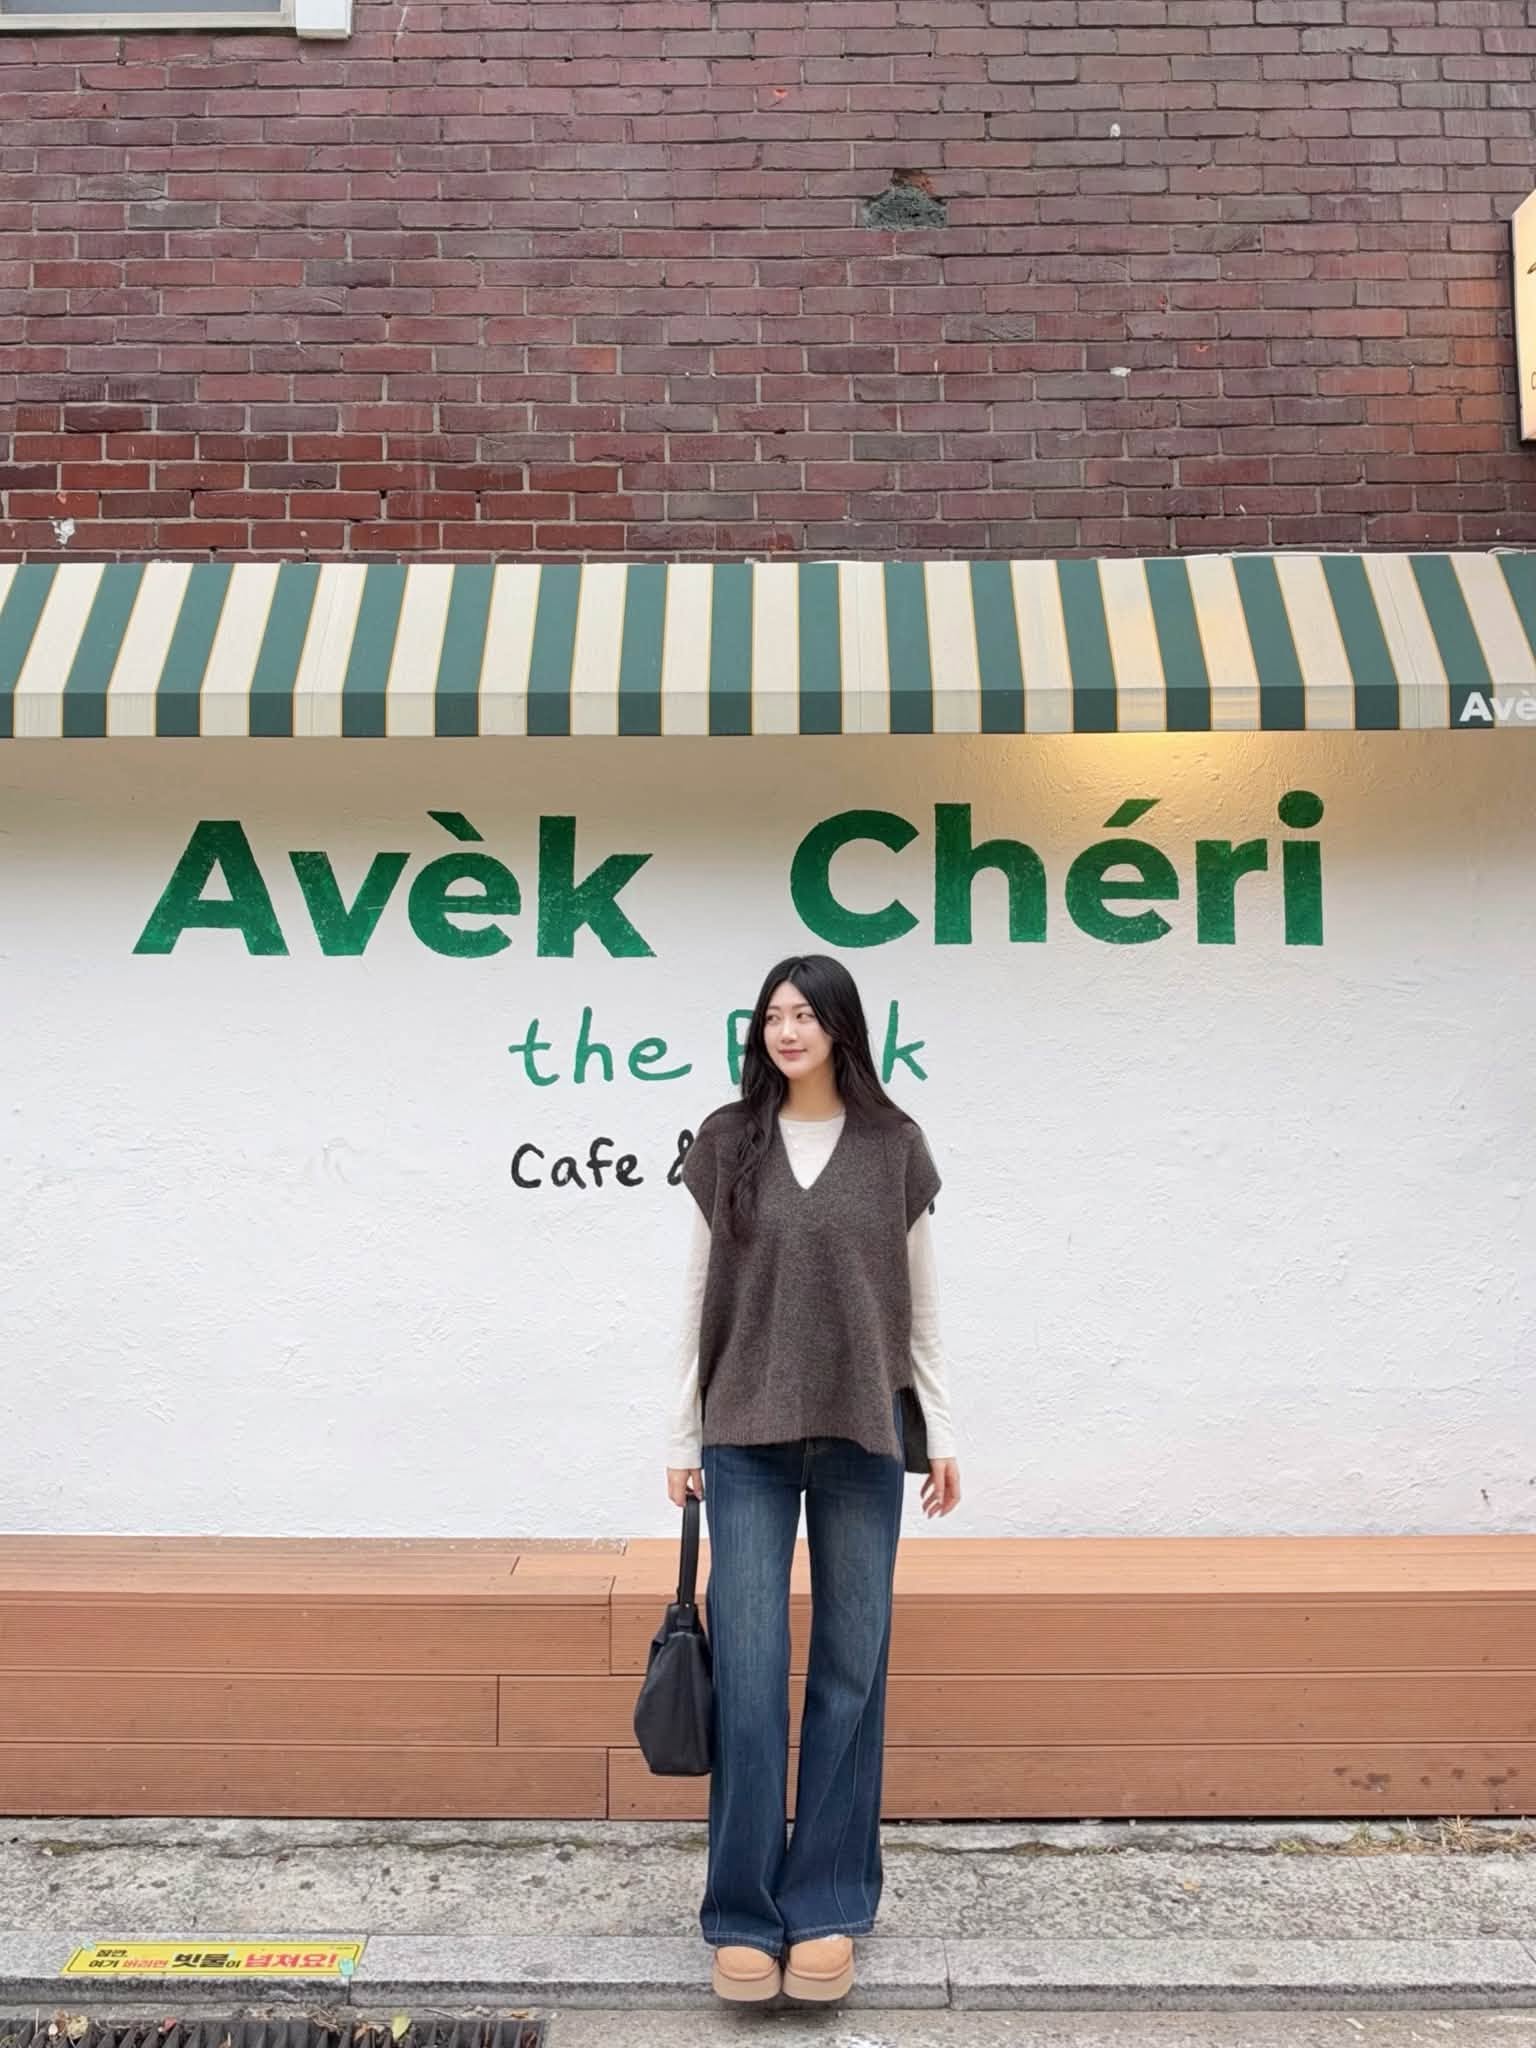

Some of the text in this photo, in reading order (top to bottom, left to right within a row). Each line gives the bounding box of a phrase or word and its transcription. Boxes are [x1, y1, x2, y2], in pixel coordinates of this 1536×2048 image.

[132, 790, 1324, 958] Avèk Chéri
[508, 1000, 929, 1087] the Pk
[511, 1137, 644, 1189] Cafe
[88, 1959, 119, 1968] 여기
[171, 1953, 241, 1968] 빗물이
[244, 1953, 338, 1968] 넘쳐요!
